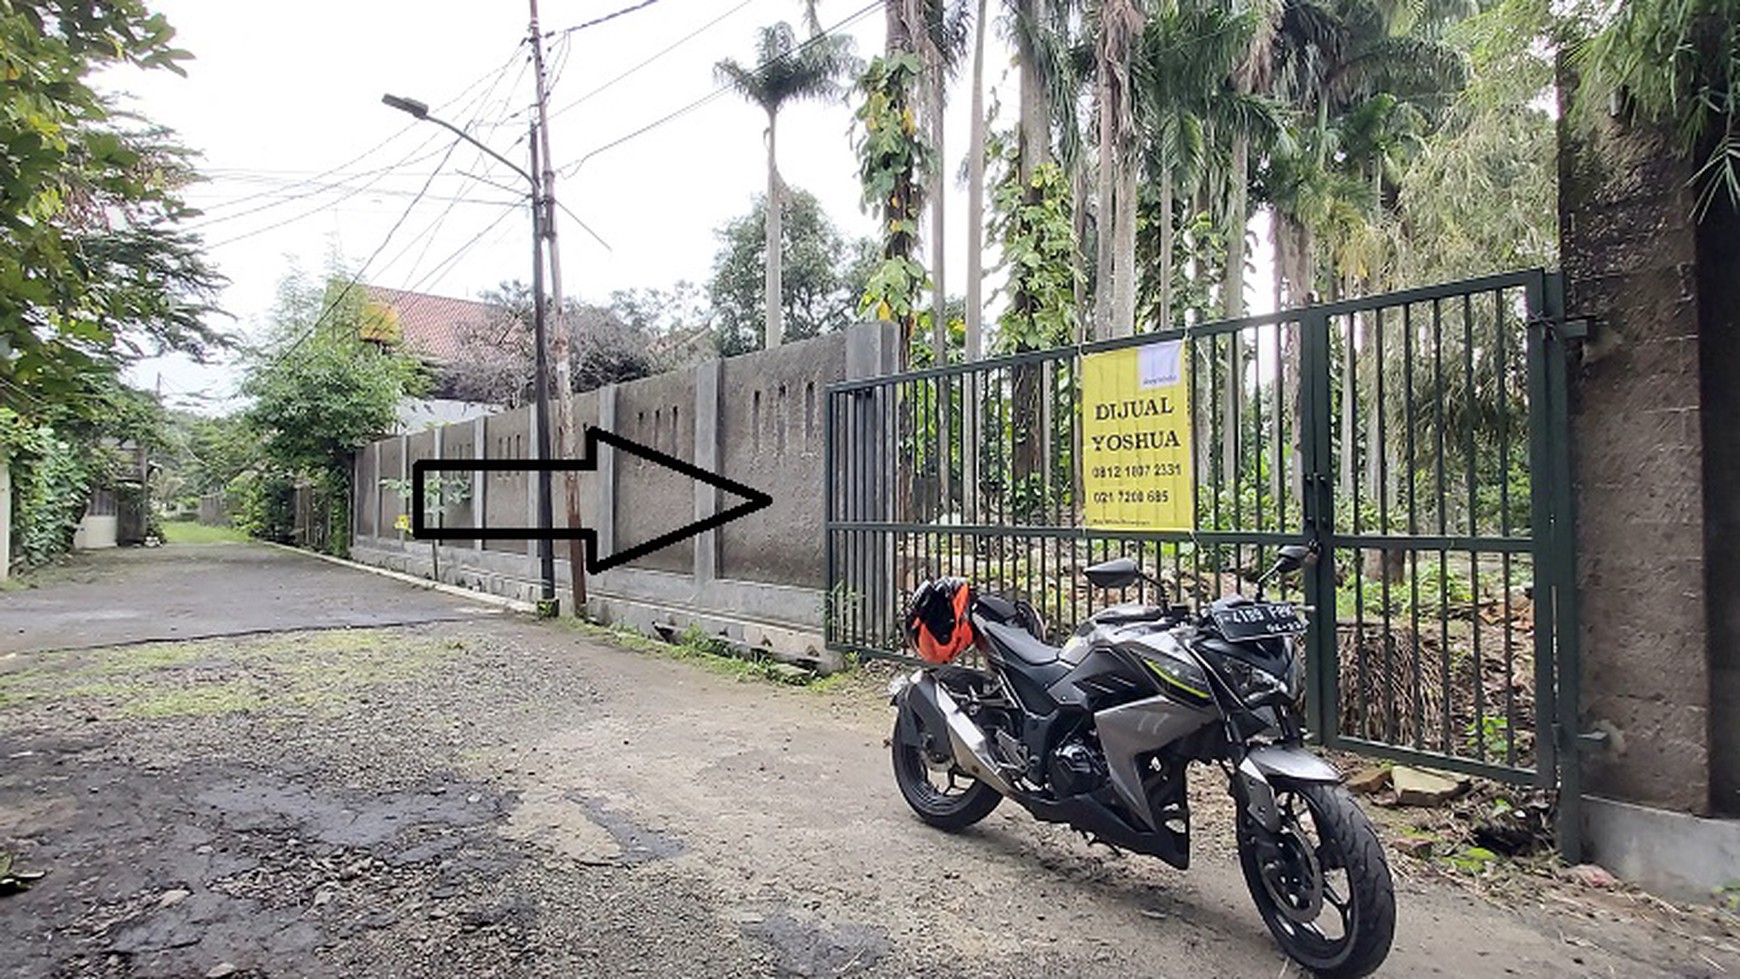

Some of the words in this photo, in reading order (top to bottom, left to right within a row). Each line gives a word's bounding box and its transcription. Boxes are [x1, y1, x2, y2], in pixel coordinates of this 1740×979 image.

[1096, 397, 1174, 420] DIJUAL
[1091, 430, 1180, 452] YOSHUA
[1092, 466, 1121, 478] 0812
[1125, 465, 1150, 478] 1807
[1154, 463, 1181, 477] 2331
[1093, 491, 1113, 503] 021
